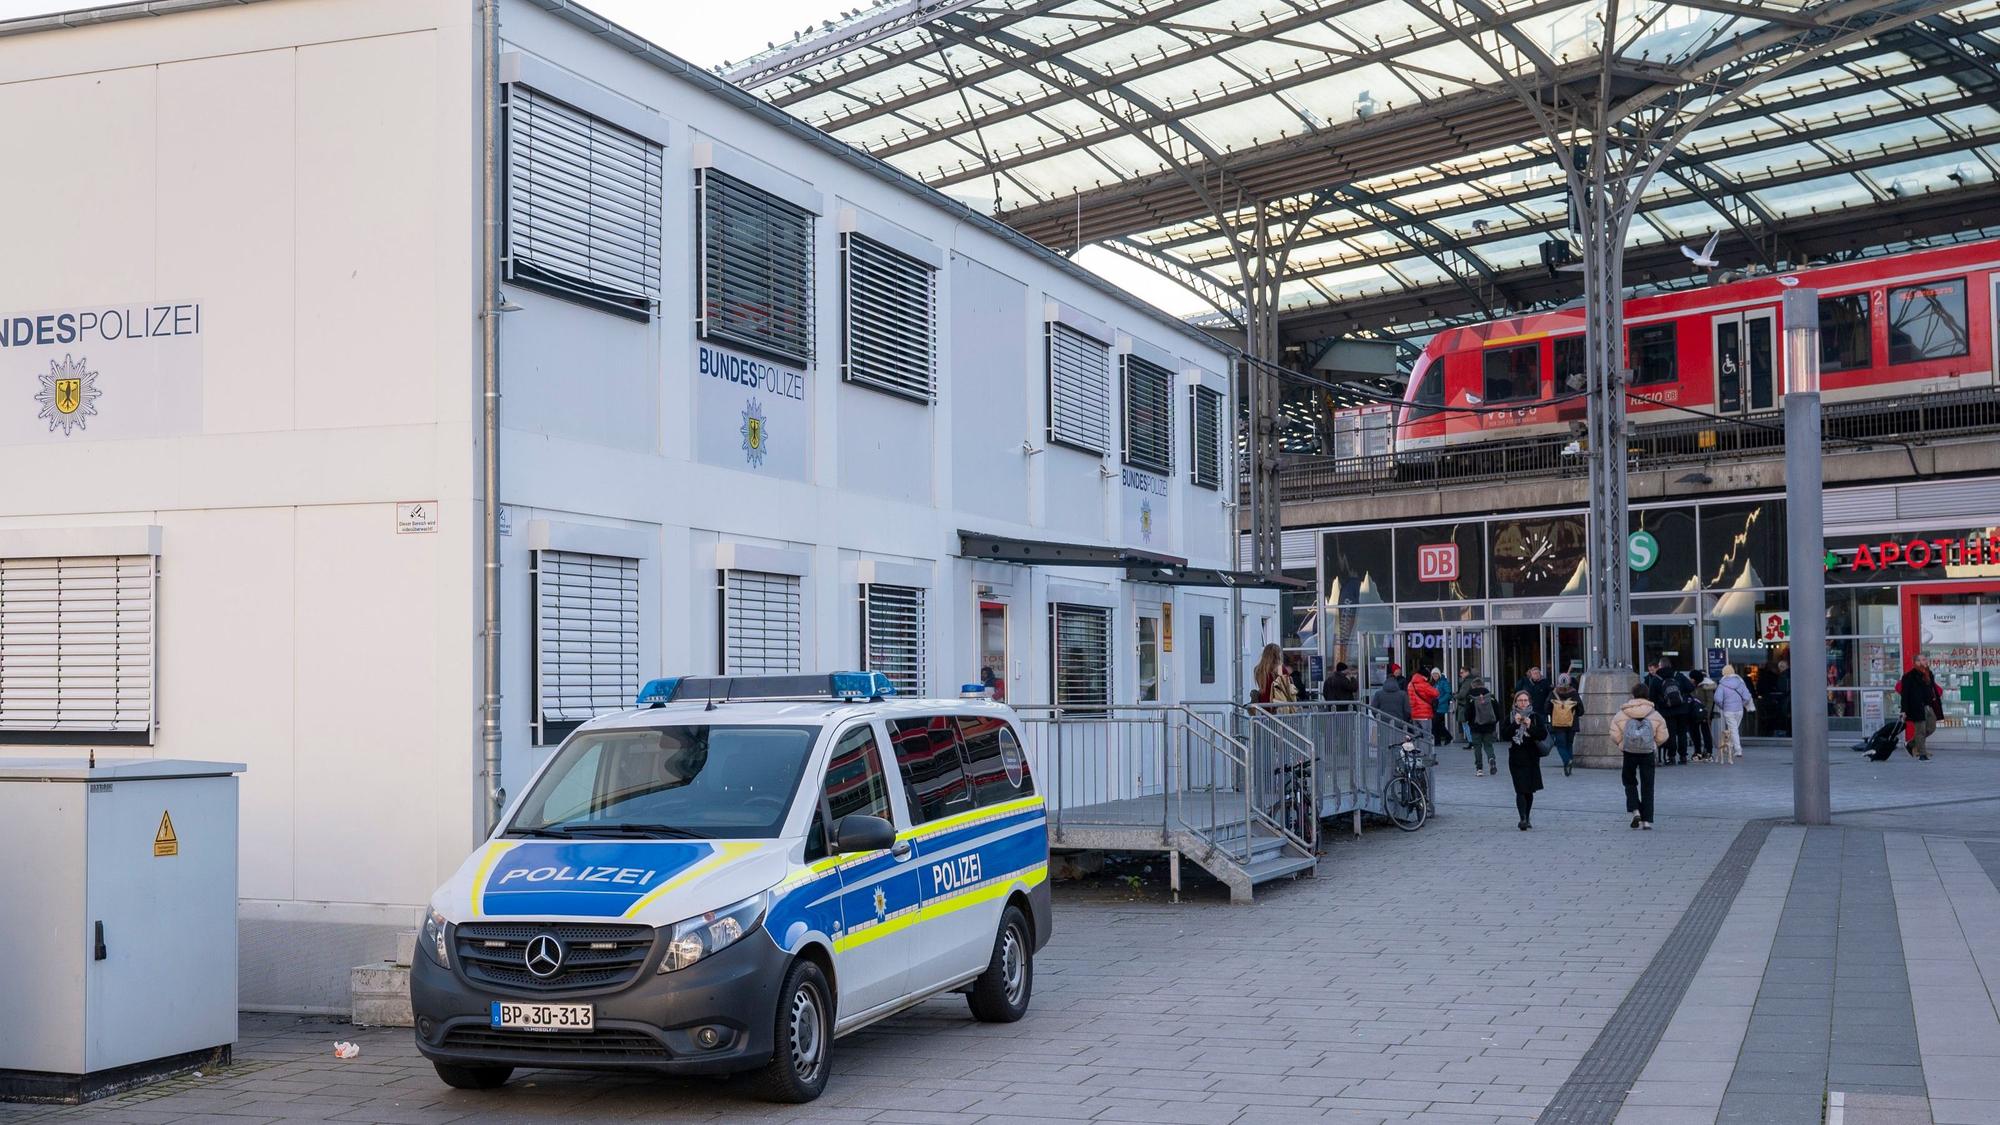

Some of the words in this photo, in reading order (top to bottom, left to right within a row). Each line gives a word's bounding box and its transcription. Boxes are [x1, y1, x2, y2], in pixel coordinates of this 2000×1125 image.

[1874, 290, 1883, 305] 2
[700, 347, 805, 401] BUNDESPOLIZEI
[1122, 468, 1168, 497] BUNDESPOLIZEI
[1423, 550, 1453, 576] DB
[1630, 535, 1651, 567] S
[499, 866, 656, 885] POLIZEI
[932, 853, 982, 894] POLIZEI
[502, 1006, 522, 1023] BP
[532, 1007, 590, 1025] 30-313
